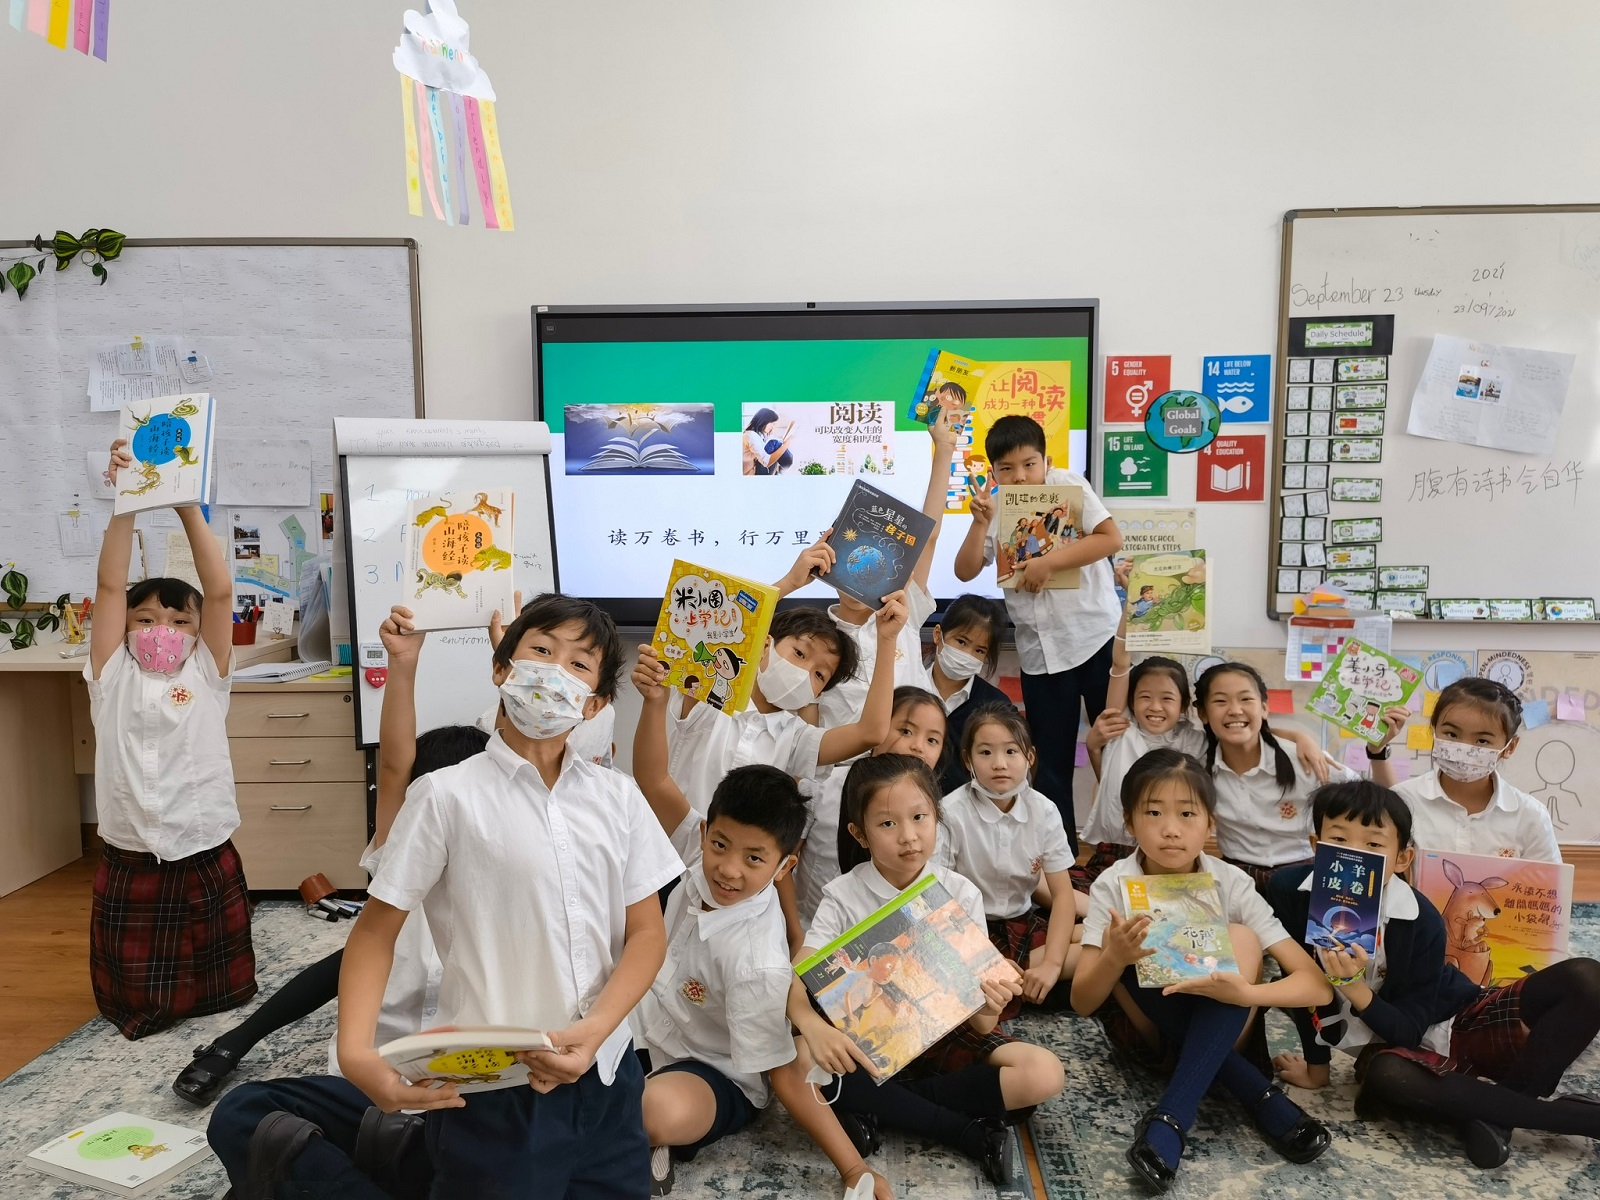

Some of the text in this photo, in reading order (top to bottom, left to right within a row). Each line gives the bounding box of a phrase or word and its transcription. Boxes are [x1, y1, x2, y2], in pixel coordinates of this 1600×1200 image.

[1292, 272, 1377, 310] September
[1383, 287, 1404, 303] 23
[1310, 328, 1365, 339] Daily Schedule
[1111, 361, 1119, 376] 5
[1207, 361, 1220, 376] 14
[983, 399, 1037, 411] 成为一种
[830, 402, 883, 425] 阅读
[1166, 409, 1199, 420] Global
[815, 426, 883, 435] 可以改变人生的
[1169, 424, 1197, 435] Goals
[833, 435, 883, 444] 宽度和厚度
[1108, 436, 1121, 451] 15
[1216, 440, 1237, 448] QUALITY
[1130, 443, 1144, 451] LAND
[1216, 448, 1244, 456] EDUCATION
[442, 526, 455, 562] 山海经
[457, 519, 471, 566] 陪孩子读
[1124, 535, 1176, 543] JUNIOR SCHOOL
[1121, 544, 1181, 552] ESTORATIVE STEPS
[675, 586, 724, 611] 米小圈
[686, 609, 731, 631] 上学记
[1345, 656, 1387, 678] 姜小牙
[1511, 882, 1558, 900] 永遠不想
